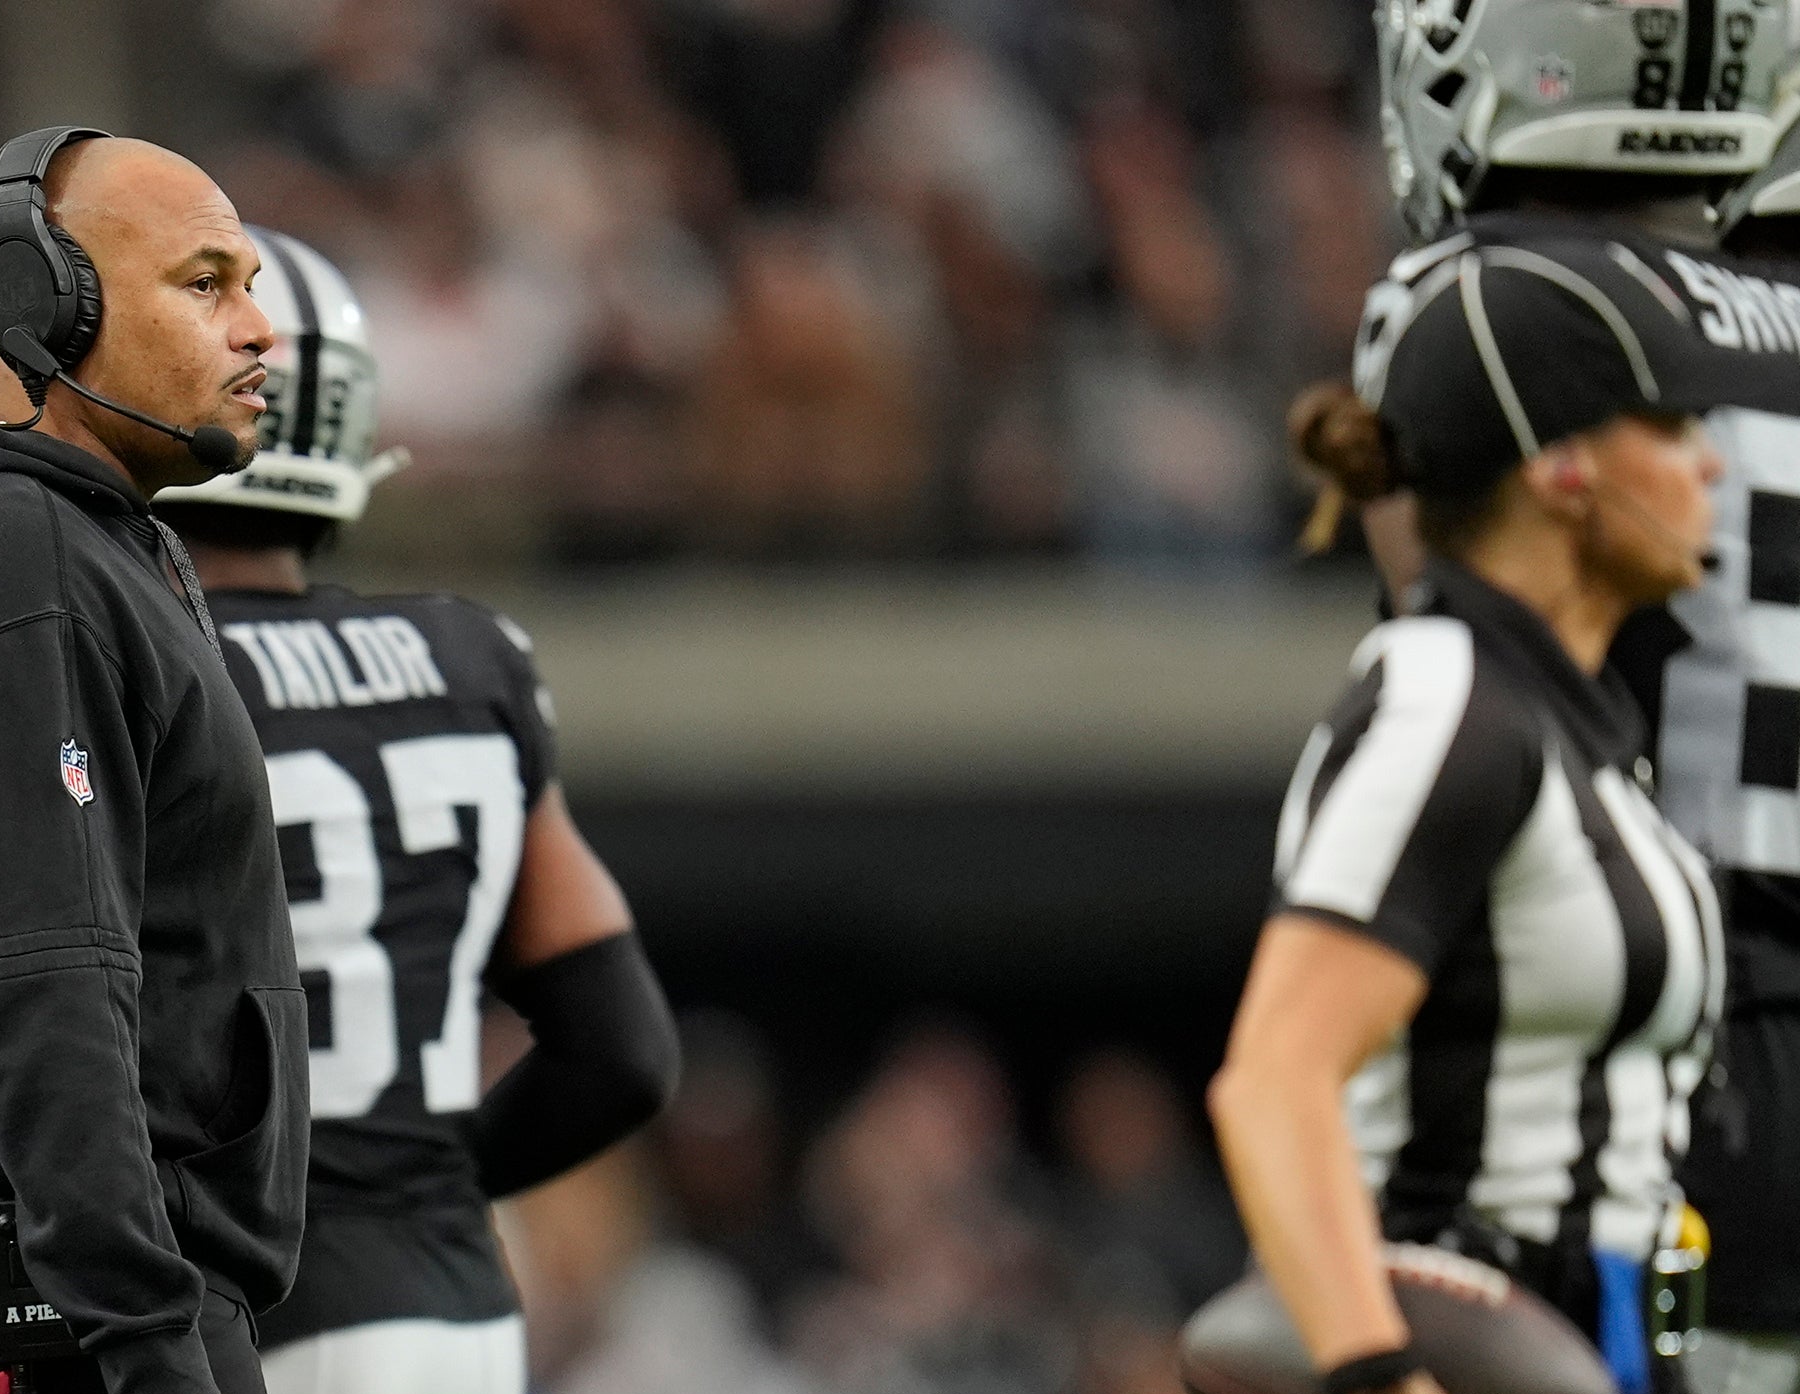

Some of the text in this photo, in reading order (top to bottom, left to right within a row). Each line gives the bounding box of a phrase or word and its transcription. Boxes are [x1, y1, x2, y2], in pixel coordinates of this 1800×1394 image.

[221, 615, 449, 710] TAYLOR
[65, 765, 89, 795] NFL
[6, 1304, 63, 1324] A PIE
